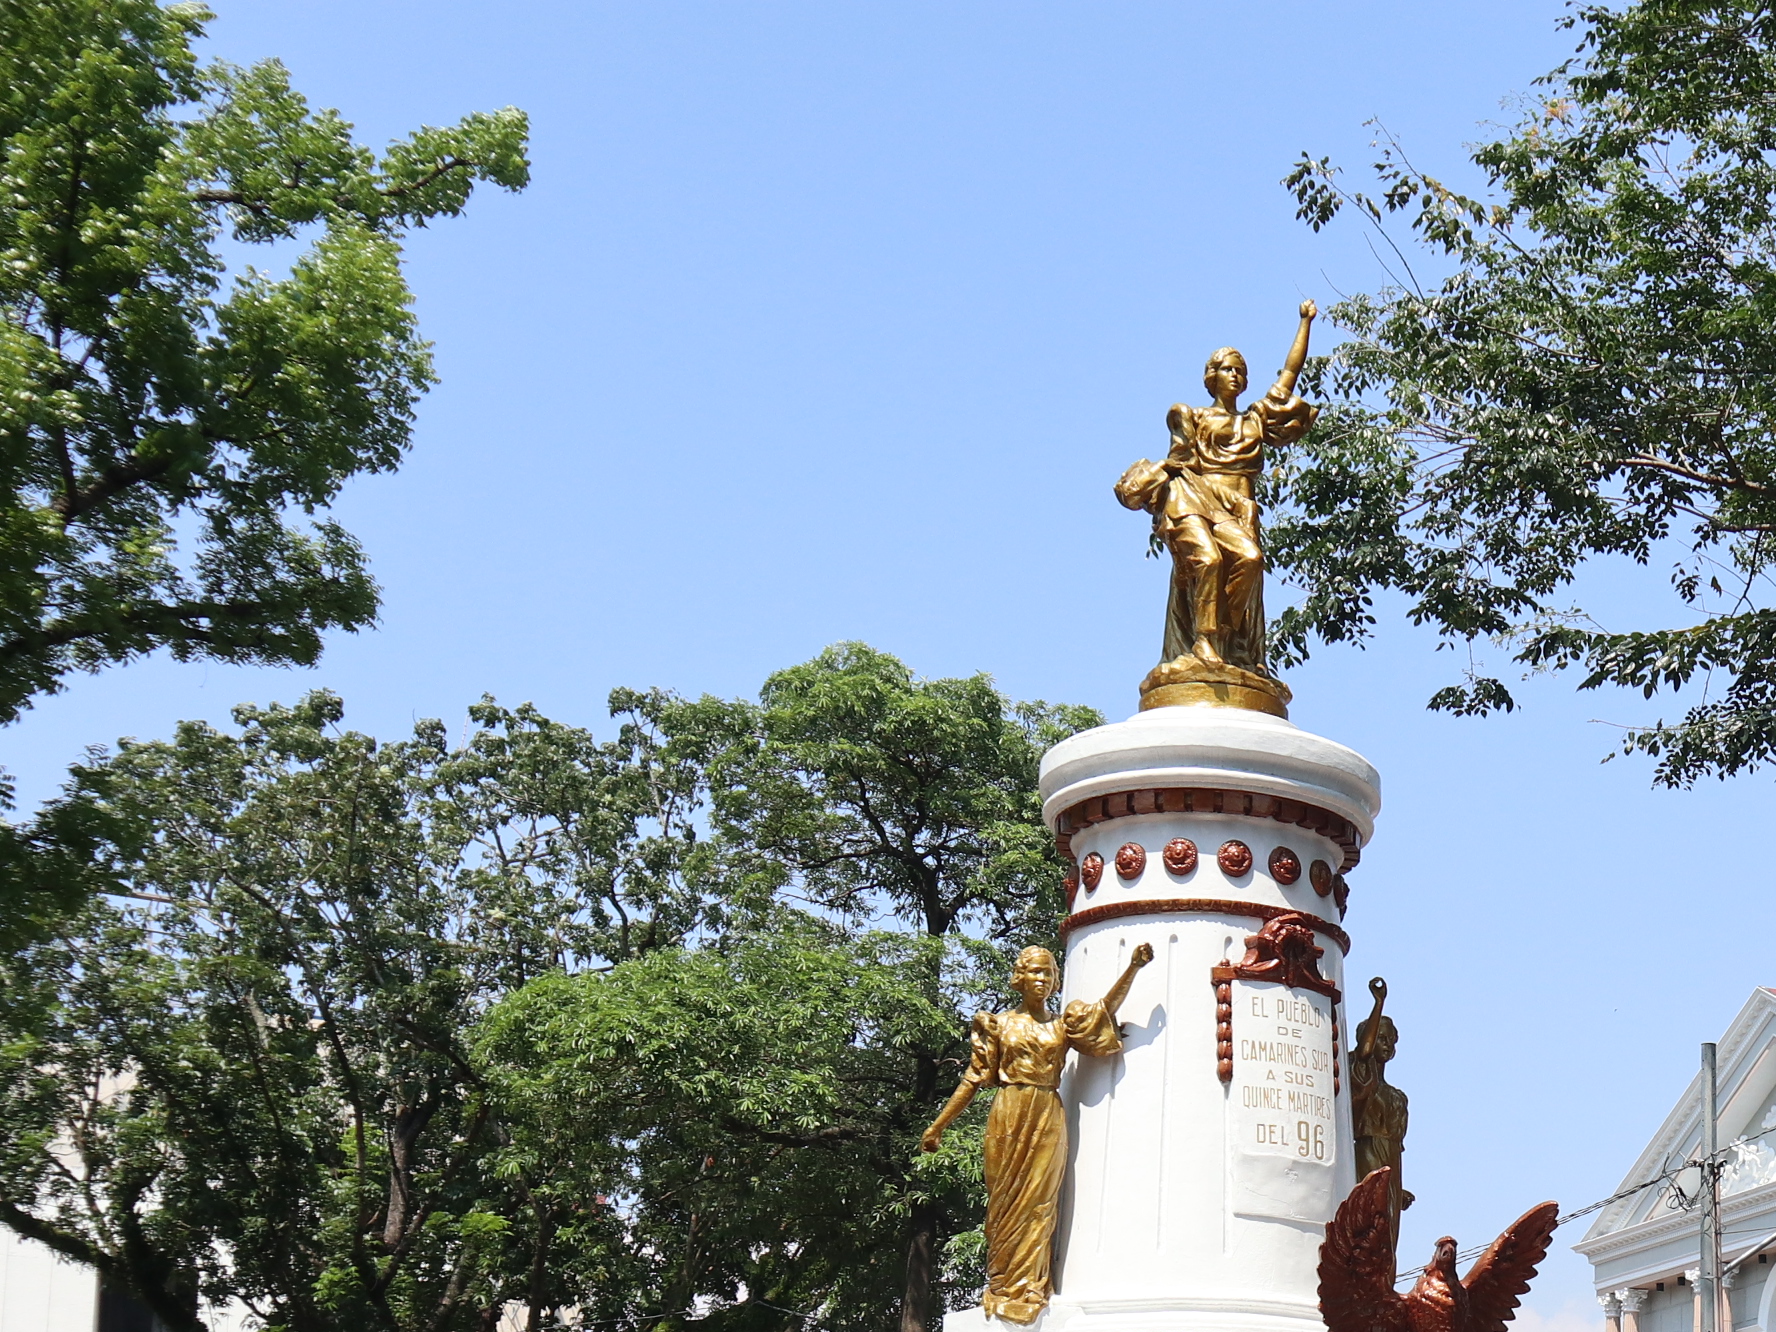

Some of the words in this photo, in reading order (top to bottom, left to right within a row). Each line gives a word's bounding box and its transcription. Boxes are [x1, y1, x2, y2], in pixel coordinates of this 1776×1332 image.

[1252, 996, 1268, 1018] EL
[1277, 999, 1321, 1028] PUEBLO
[1277, 1026, 1302, 1038] DE
[1241, 1039, 1307, 1068] CAMARINES
[1312, 1049, 1329, 1073] SUR
[1266, 1069, 1276, 1081] A
[1284, 1071, 1314, 1087] SUS
[1243, 1085, 1282, 1110] QUINCE
[1288, 1090, 1331, 1120] MARTIRES
[1257, 1124, 1289, 1146] DEL
[1297, 1121, 1325, 1161] 96
